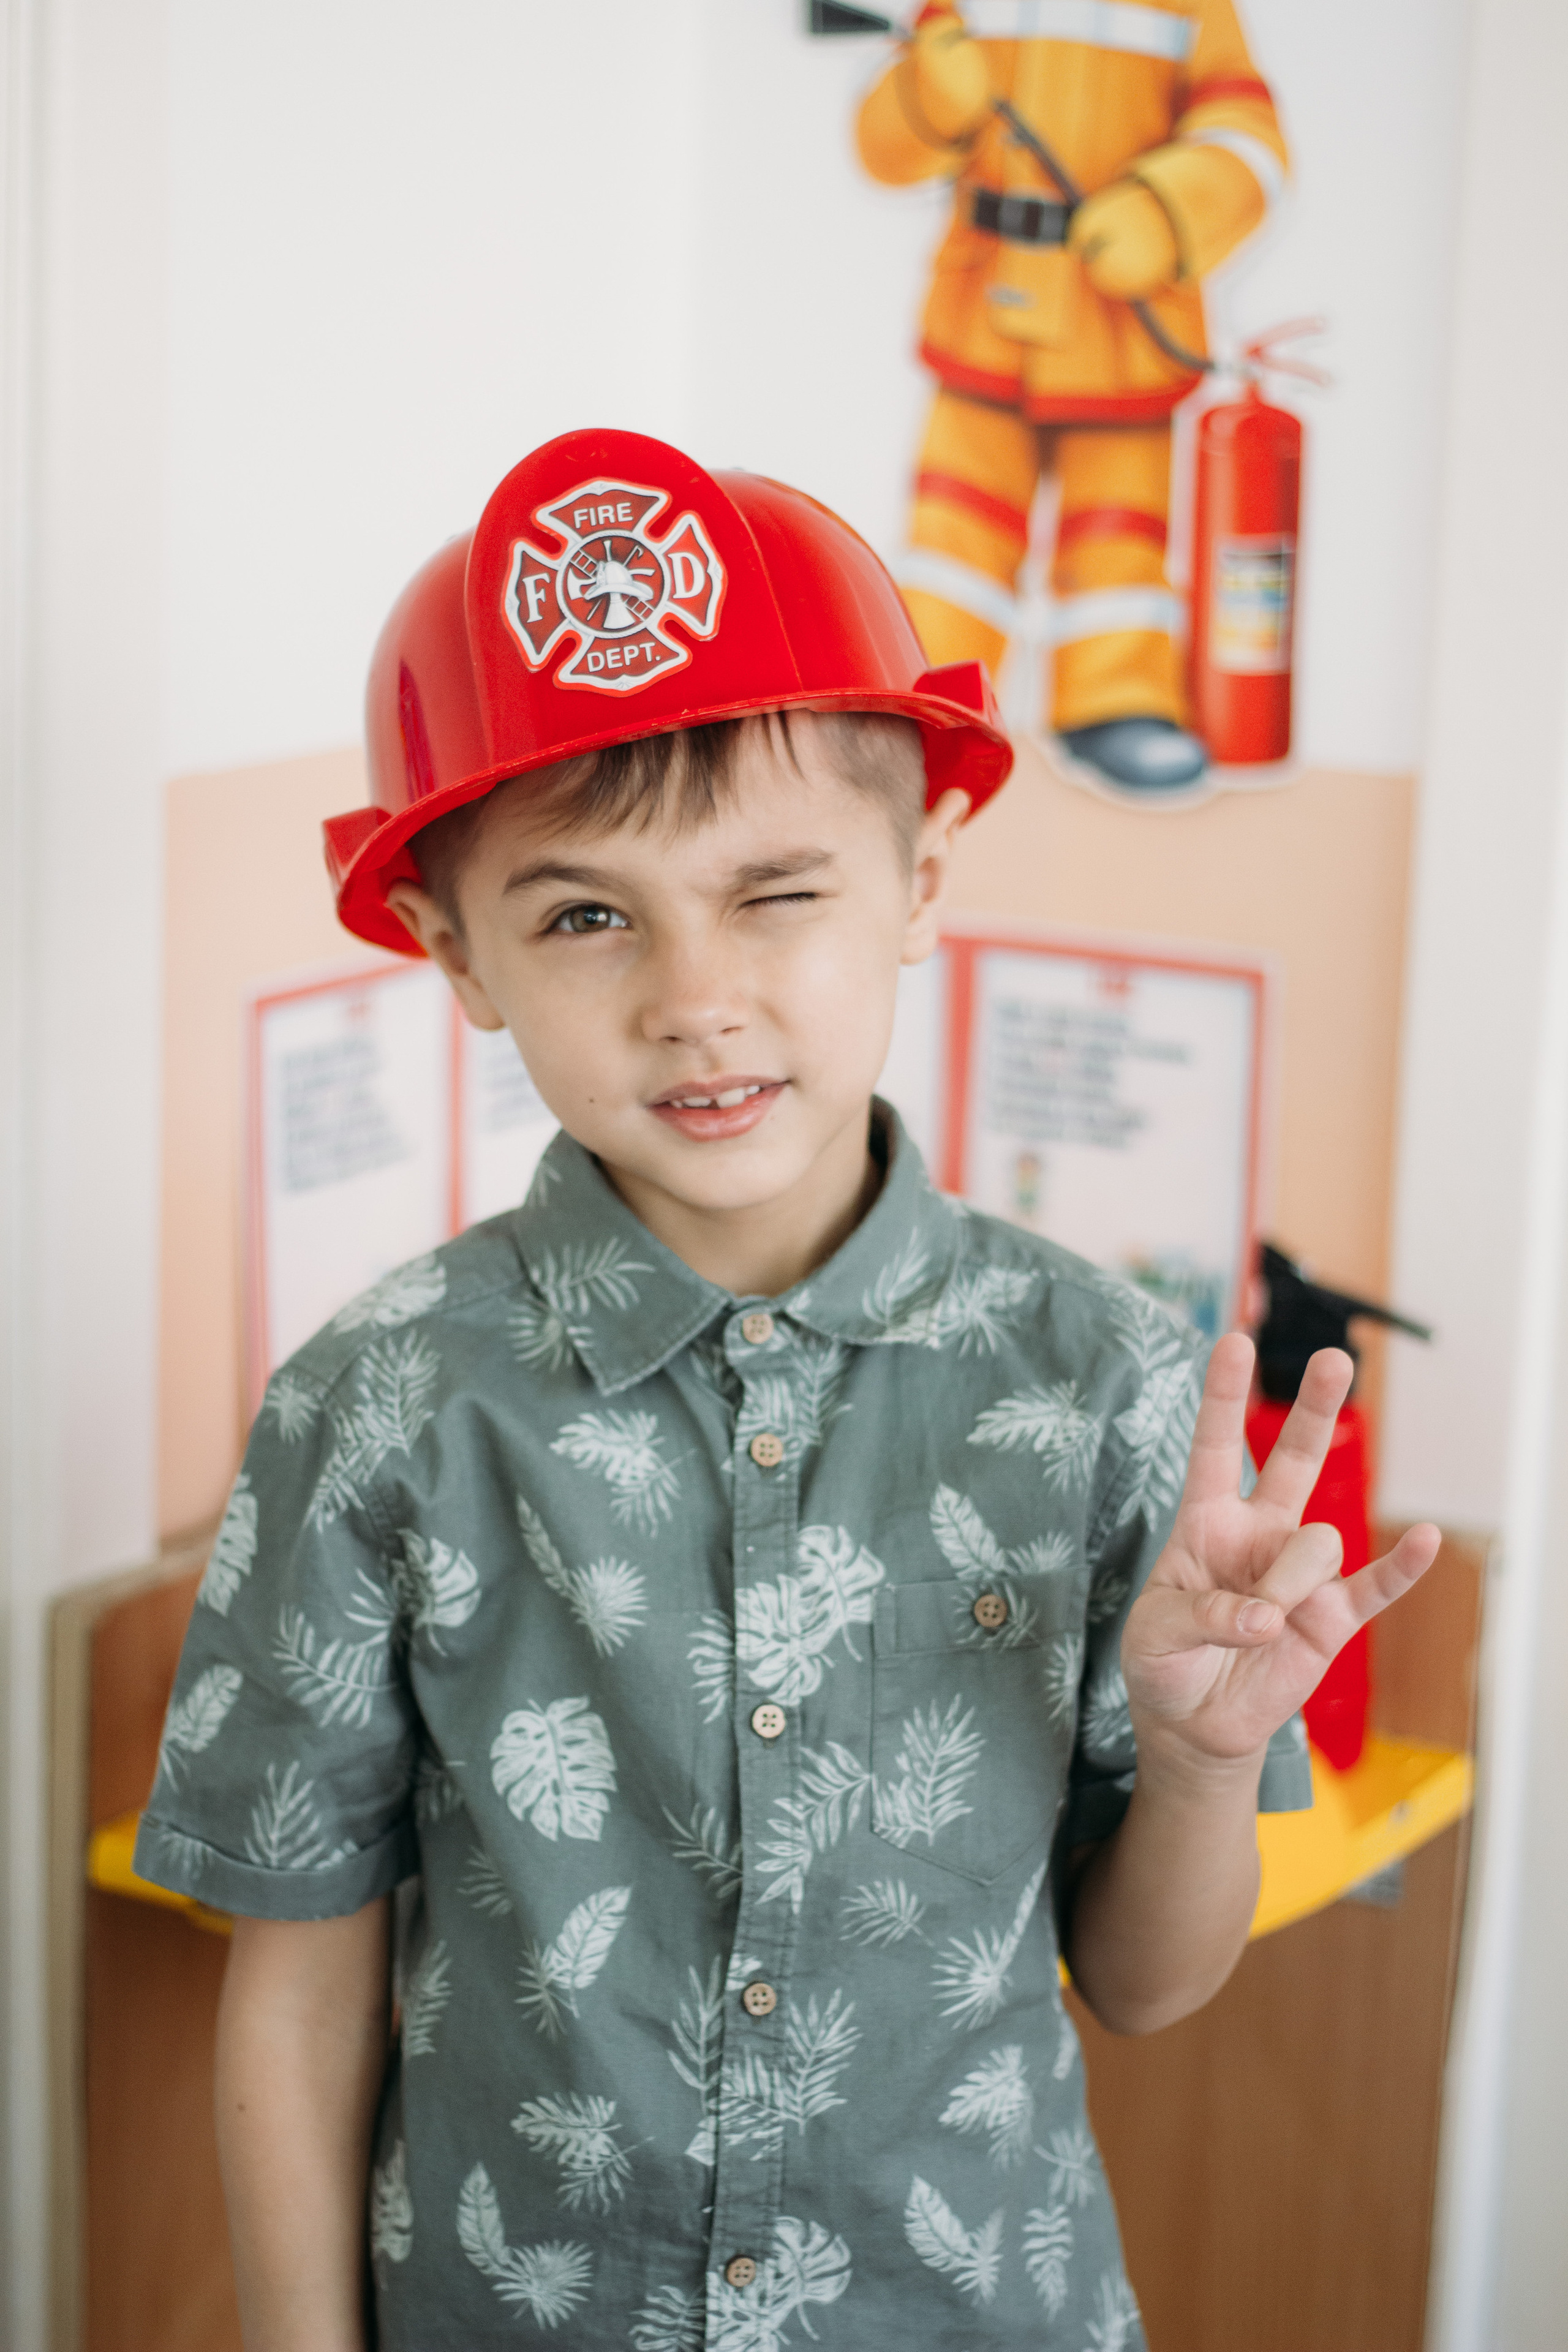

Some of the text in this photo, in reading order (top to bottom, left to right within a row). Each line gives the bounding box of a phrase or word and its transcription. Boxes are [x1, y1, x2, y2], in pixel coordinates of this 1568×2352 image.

[573, 502, 633, 529] FIRE
[522, 552, 706, 623] F D
[587, 642, 661, 673] DEPT.
